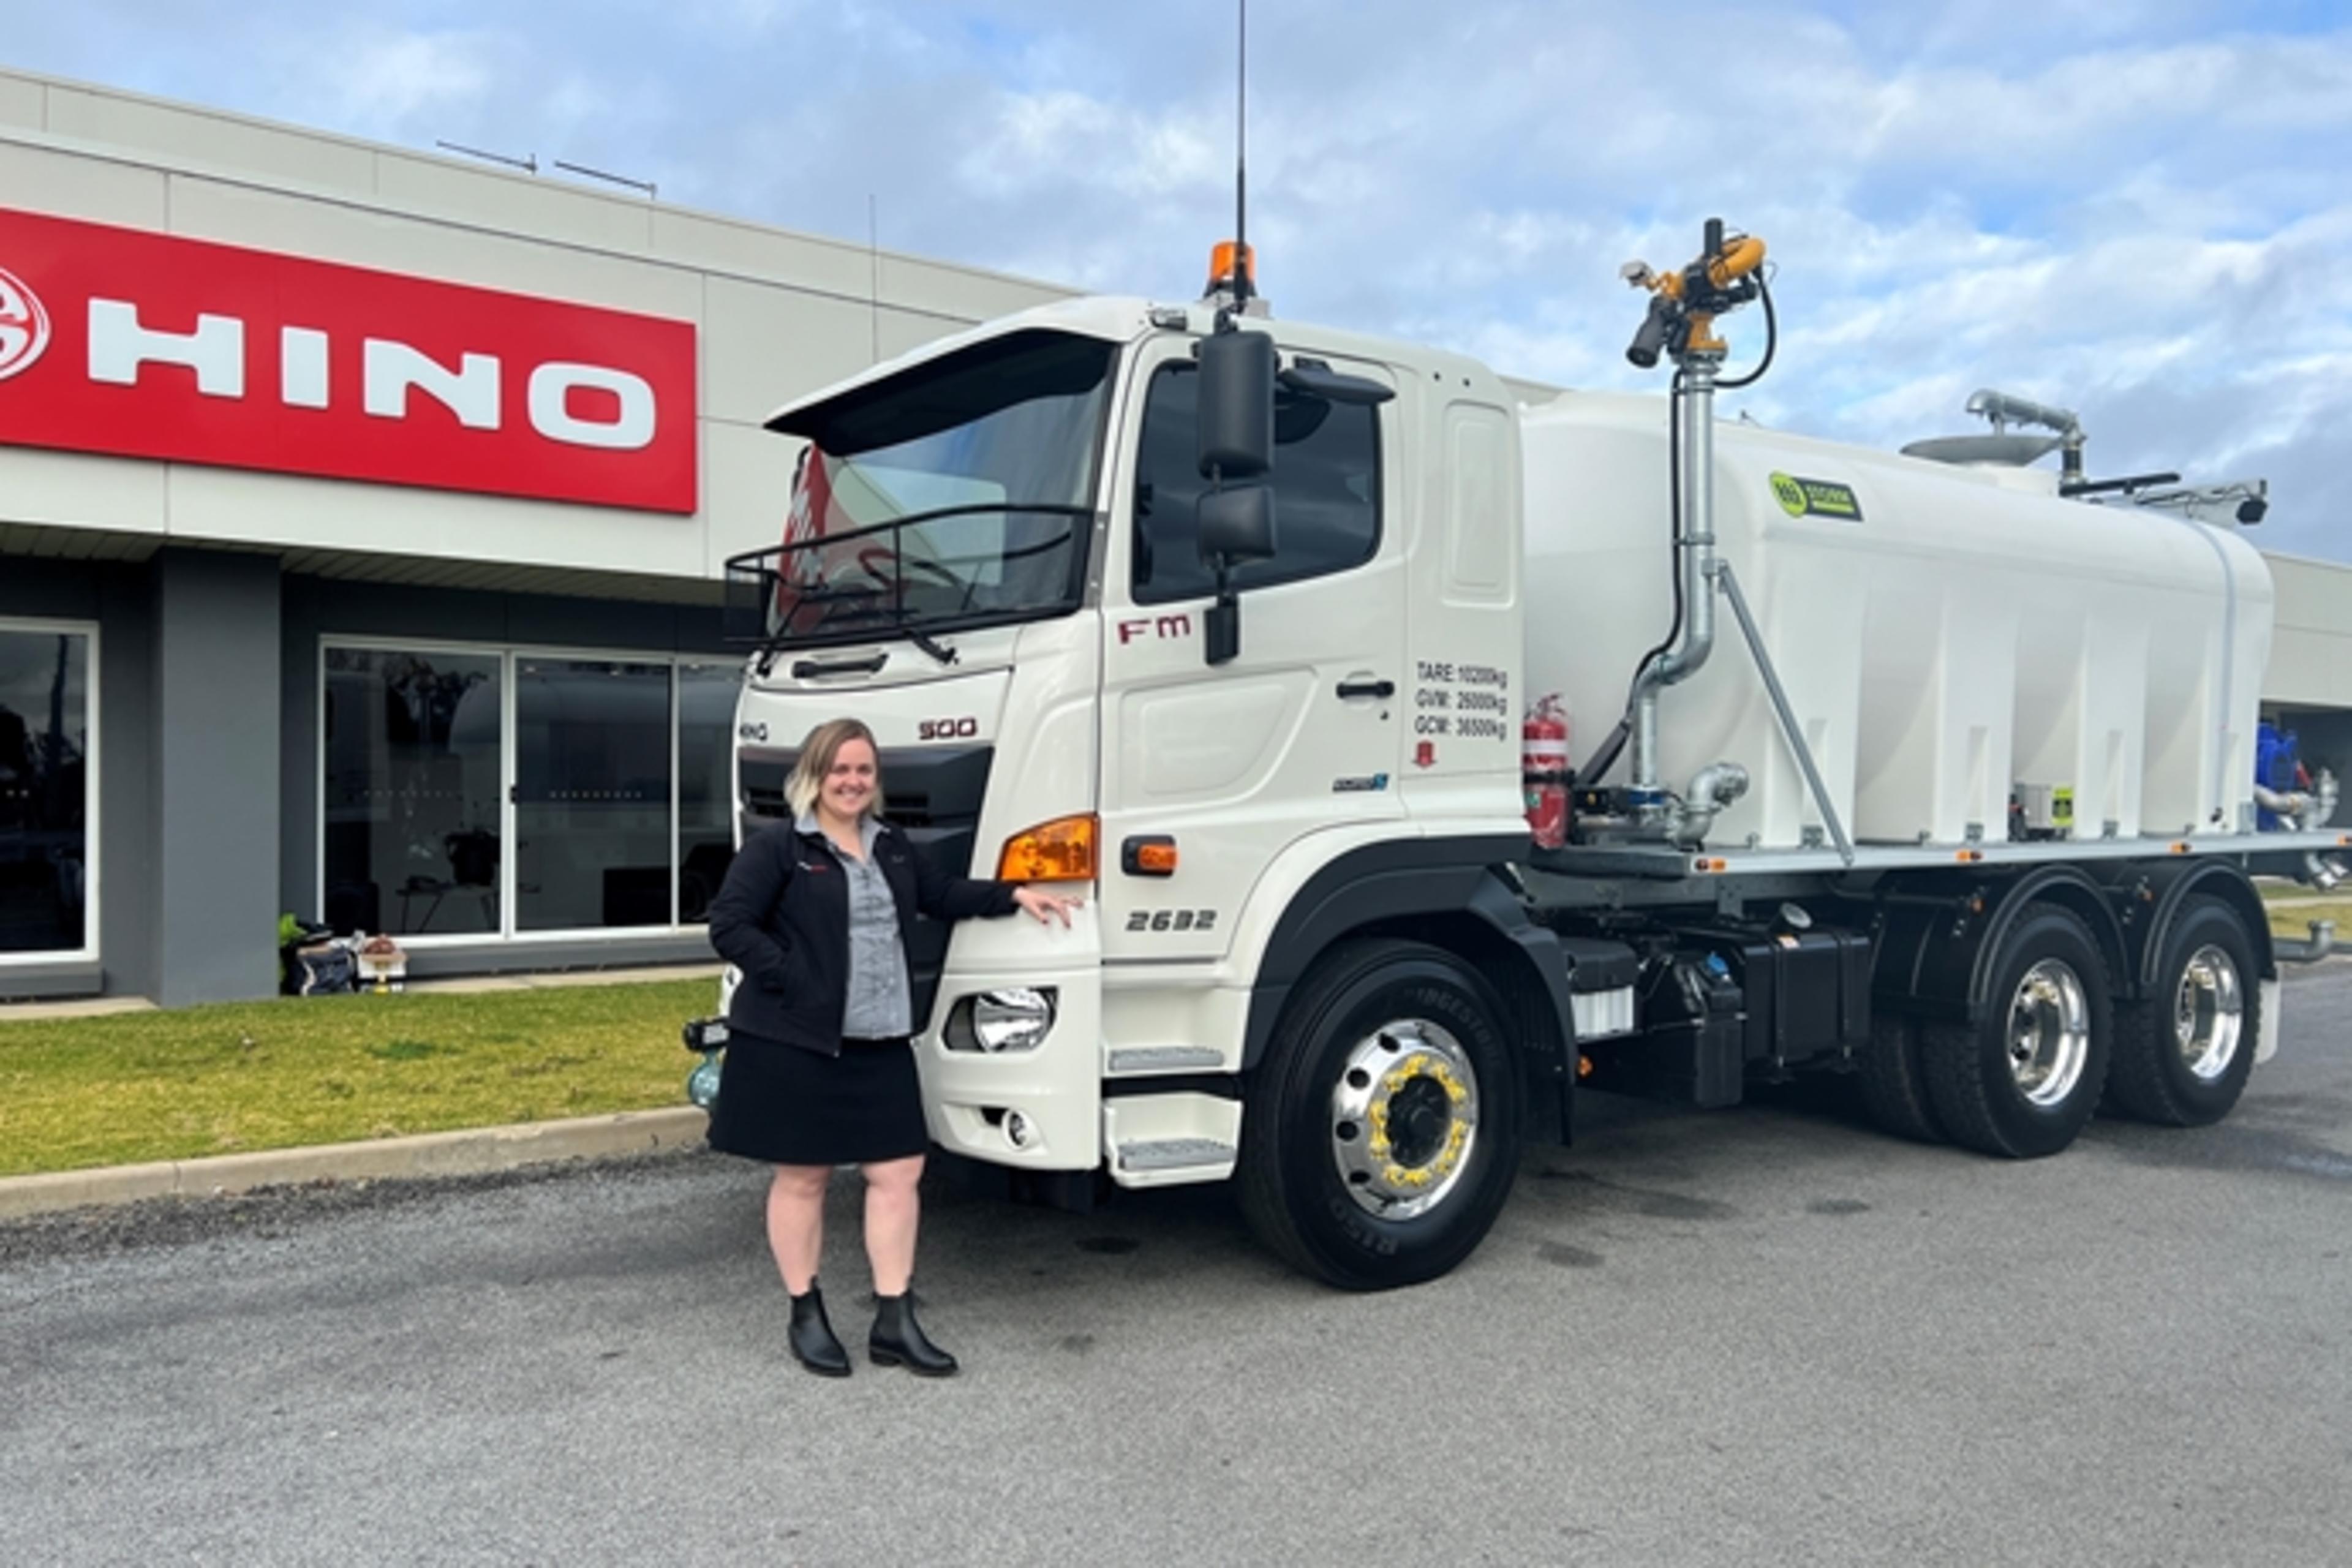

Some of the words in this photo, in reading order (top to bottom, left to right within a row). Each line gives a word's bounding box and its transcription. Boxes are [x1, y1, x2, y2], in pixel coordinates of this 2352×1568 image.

[88, 296, 656, 450] HINO
[1415, 688, 1451, 710] GVM:
[919, 717, 978, 740] 500
[1414, 715, 1451, 736] GCM:
[1125, 910, 1218, 932] 2632
